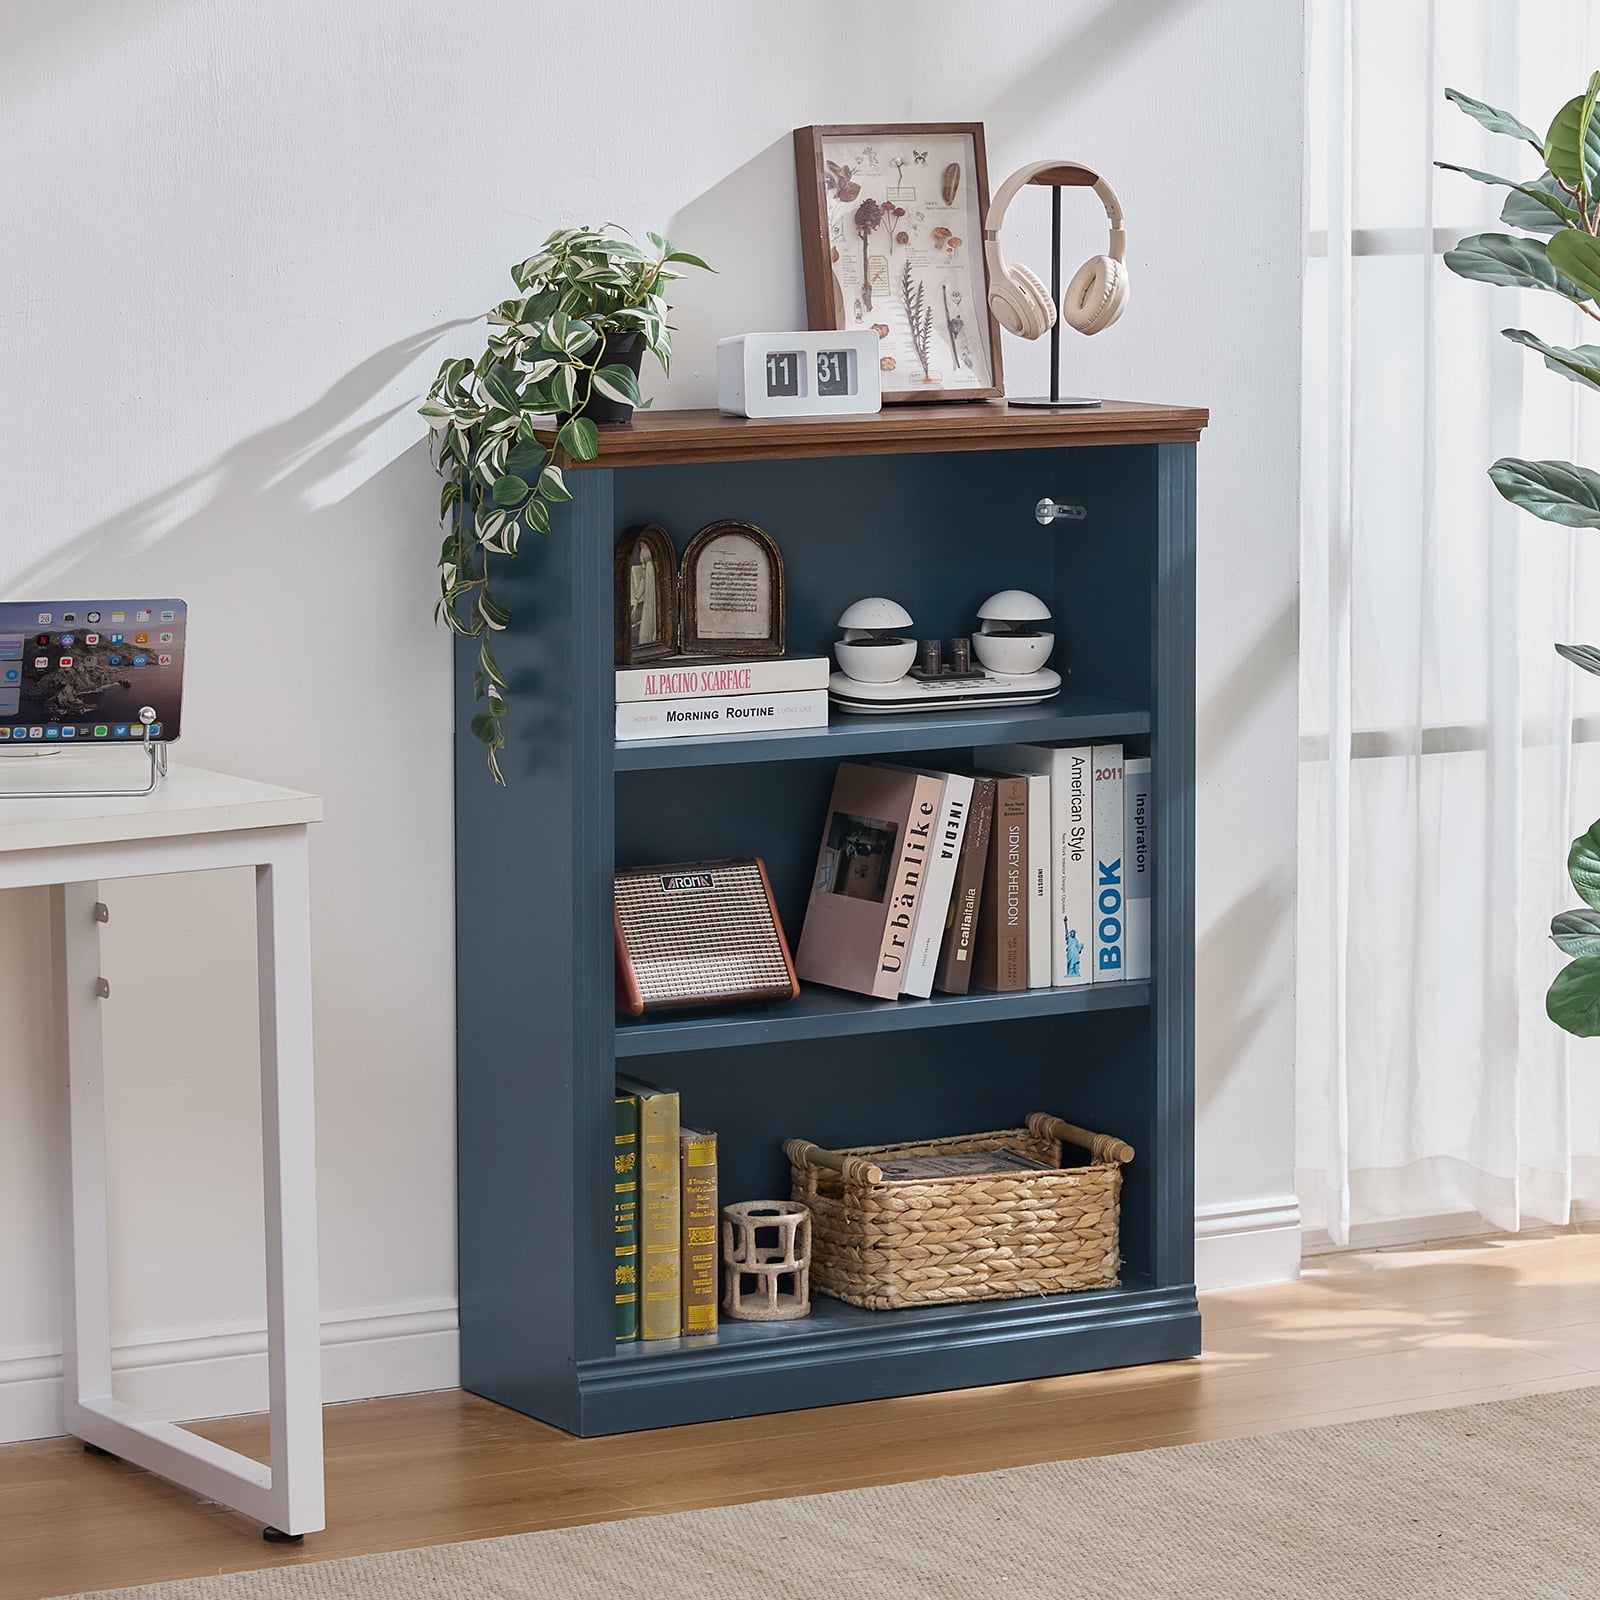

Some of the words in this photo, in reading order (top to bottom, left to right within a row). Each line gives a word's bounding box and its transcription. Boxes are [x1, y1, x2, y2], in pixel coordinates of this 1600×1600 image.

[767, 357, 789, 386] 11
[817, 354, 841, 383] 31
[40, 615, 50, 623] 28
[644, 674, 658, 695] AL
[659, 672, 698, 694] PACINO
[701, 668, 752, 692] SCARFACE
[666, 710, 719, 722] MORNING
[726, 707, 774, 719] ROUTINE
[1071, 756, 1085, 822] American
[1095, 768, 1123, 781] 2011
[941, 801, 963, 859] INEDIA
[1008, 825, 1020, 867] SIDNEY
[1067, 826, 1085, 862] Style
[1134, 793, 1147, 873] Inspiration
[668, 876, 710, 889] AROMA
[1007, 870, 1019, 926] SHELDON
[960, 888, 976, 946] caliaitalia
[1098, 857, 1122, 970] BOOK
